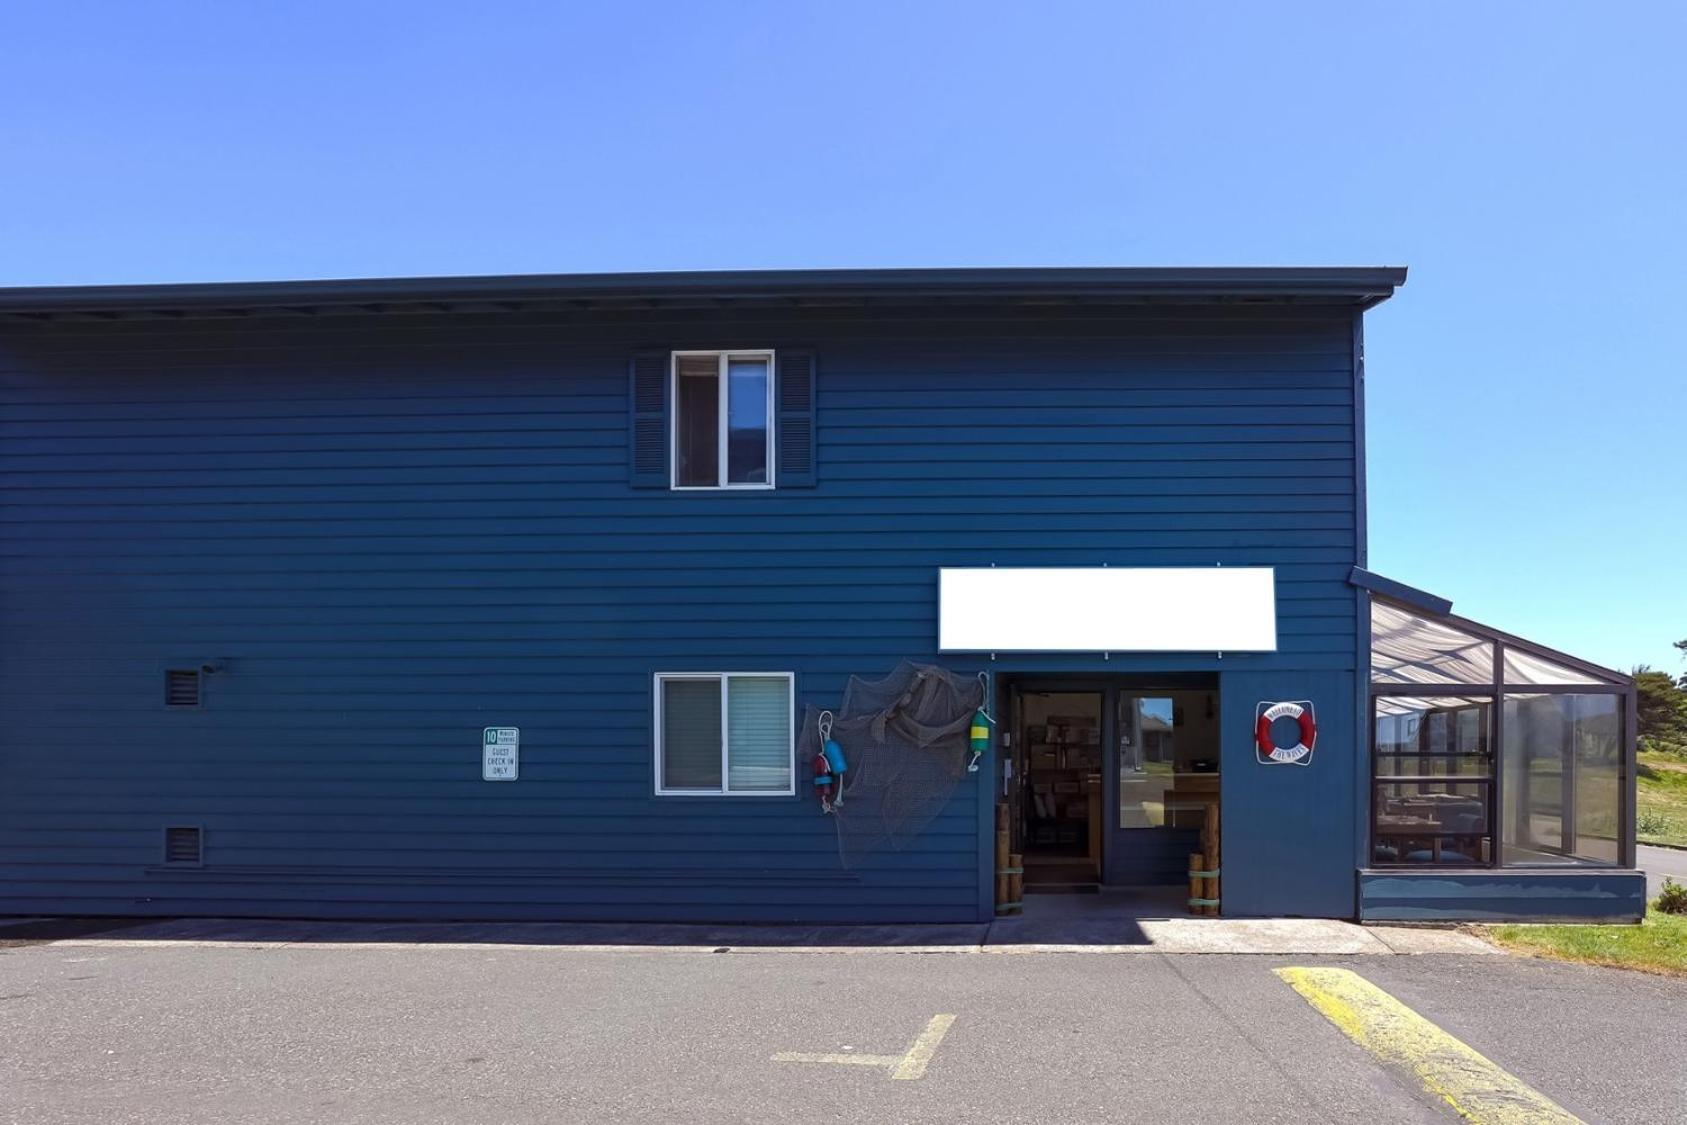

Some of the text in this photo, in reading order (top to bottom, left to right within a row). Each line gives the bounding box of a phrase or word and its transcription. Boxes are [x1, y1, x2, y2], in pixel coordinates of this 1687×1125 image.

[487, 731, 497, 743] 10
[493, 748, 509, 756] GUEST
[488, 757, 506, 766] CHECK
